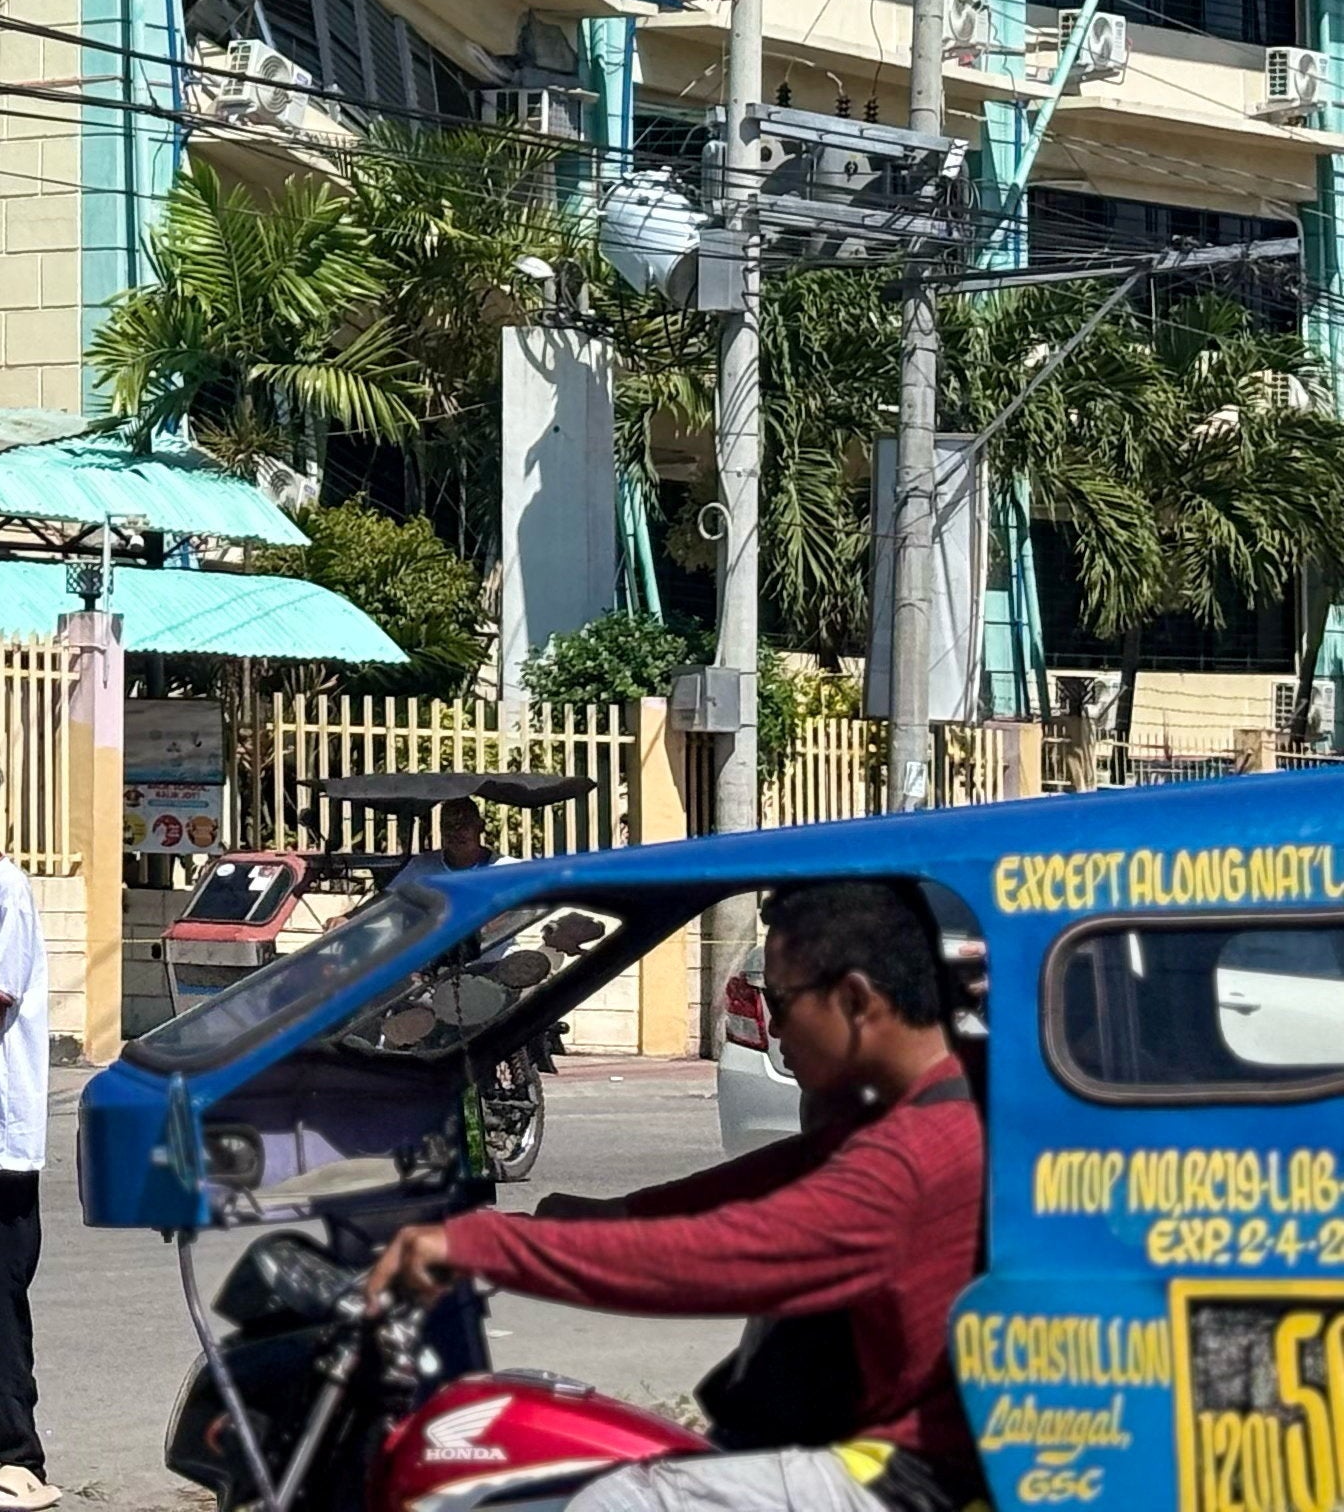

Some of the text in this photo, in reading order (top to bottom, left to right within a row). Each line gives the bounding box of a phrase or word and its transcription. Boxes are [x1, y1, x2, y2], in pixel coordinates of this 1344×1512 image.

[996, 852, 1124, 913] EXCEPT
[1130, 848, 1246, 908] ALONG
[425, 1447, 508, 1461] HONDA
[1017, 1467, 1104, 1502] GSC
